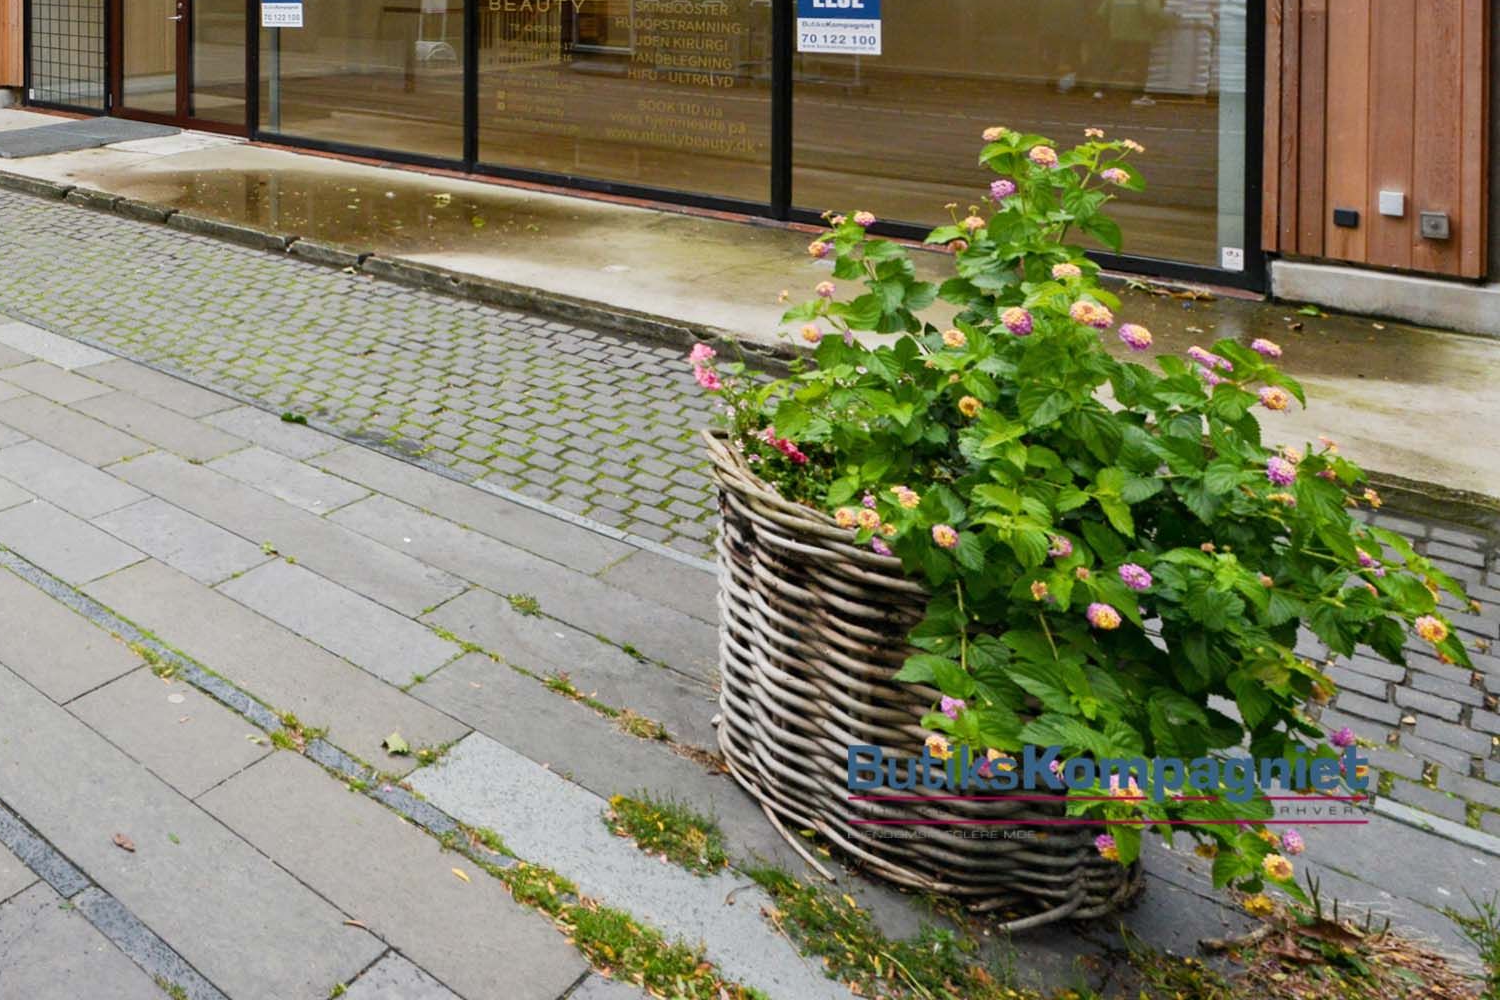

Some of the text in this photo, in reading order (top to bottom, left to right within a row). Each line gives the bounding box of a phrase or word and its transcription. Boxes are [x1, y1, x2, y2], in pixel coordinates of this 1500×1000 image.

[636, 1, 730, 17] SKINBOOSTER
[615, 16, 741, 34] HUDOPSTRAMNING
[636, 34, 729, 52] UDEN KIRURGI
[802, 34, 877, 46] 70 122 100
[631, 51, 733, 71] TANDBLEGNING
[627, 67, 658, 82] HIFU
[668, 70, 735, 89] ULTRALYD
